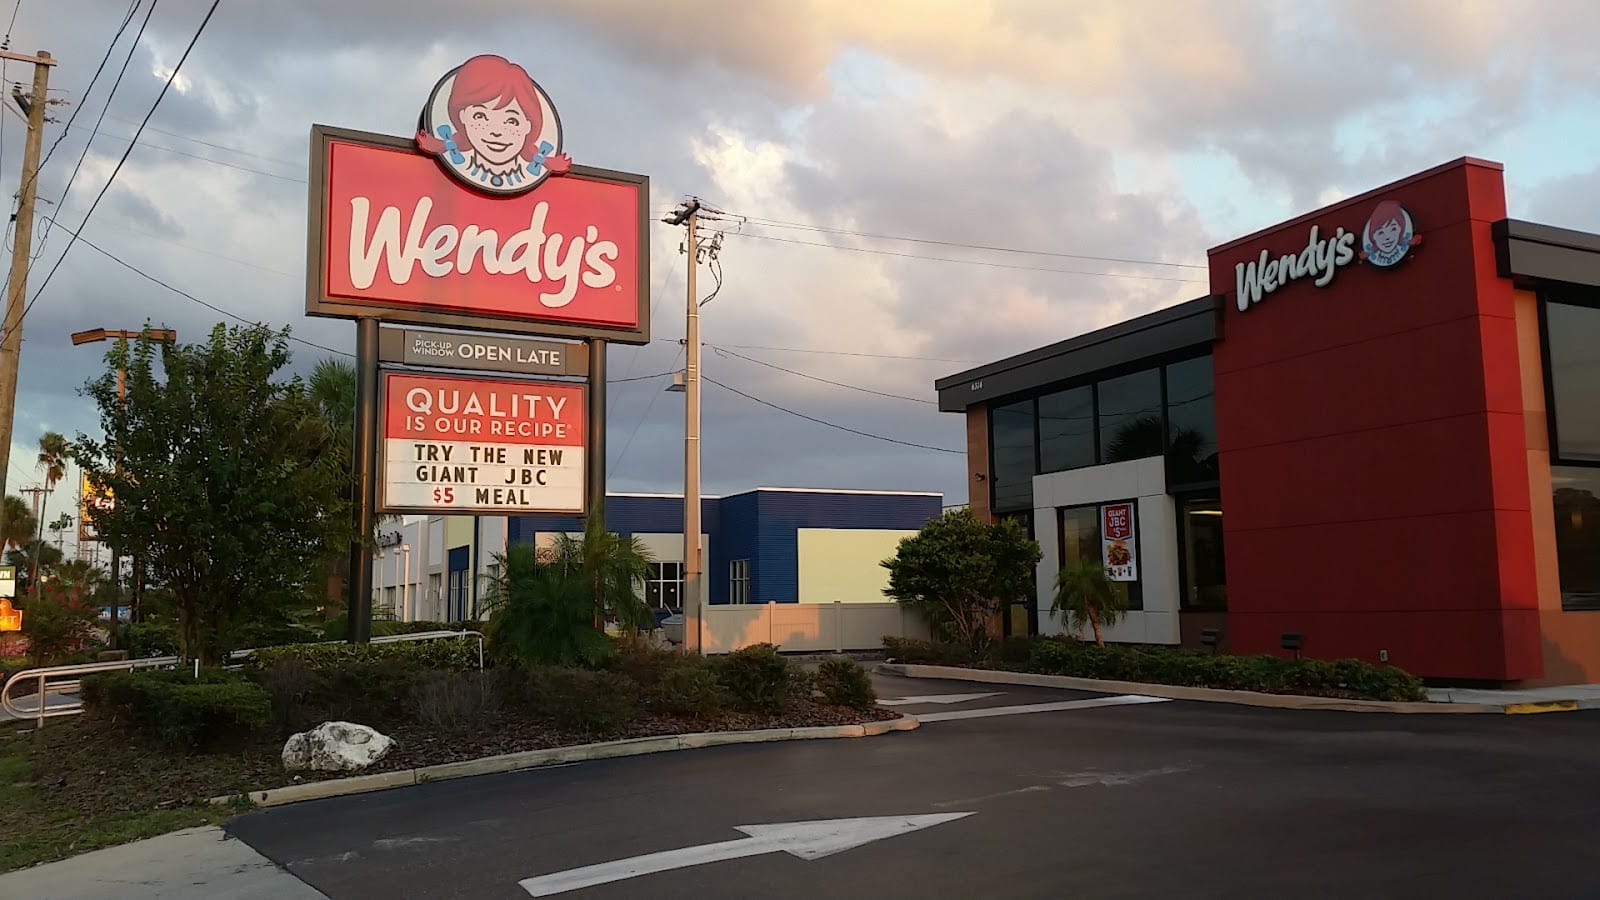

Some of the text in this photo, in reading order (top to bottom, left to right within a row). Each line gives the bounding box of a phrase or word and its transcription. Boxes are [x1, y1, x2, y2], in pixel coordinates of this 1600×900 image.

[349, 196, 619, 308] Wendy's
[1235, 224, 1355, 312] Wendy's
[412, 346, 455, 357] WINDOW
[415, 339, 452, 349] PICK-UP
[457, 343, 561, 366] OPEN LATE
[405, 387, 567, 420] QUALITY
[405, 415, 426, 431] IS
[434, 417, 482, 434] OUR
[414, 443, 564, 466] TRY THE NEW
[416, 465, 547, 486] GIANT JBC
[433, 486, 530, 506] $5 MEAL
[1108, 509, 1126, 517] GIANT
[1109, 517, 1126, 527] JBC
